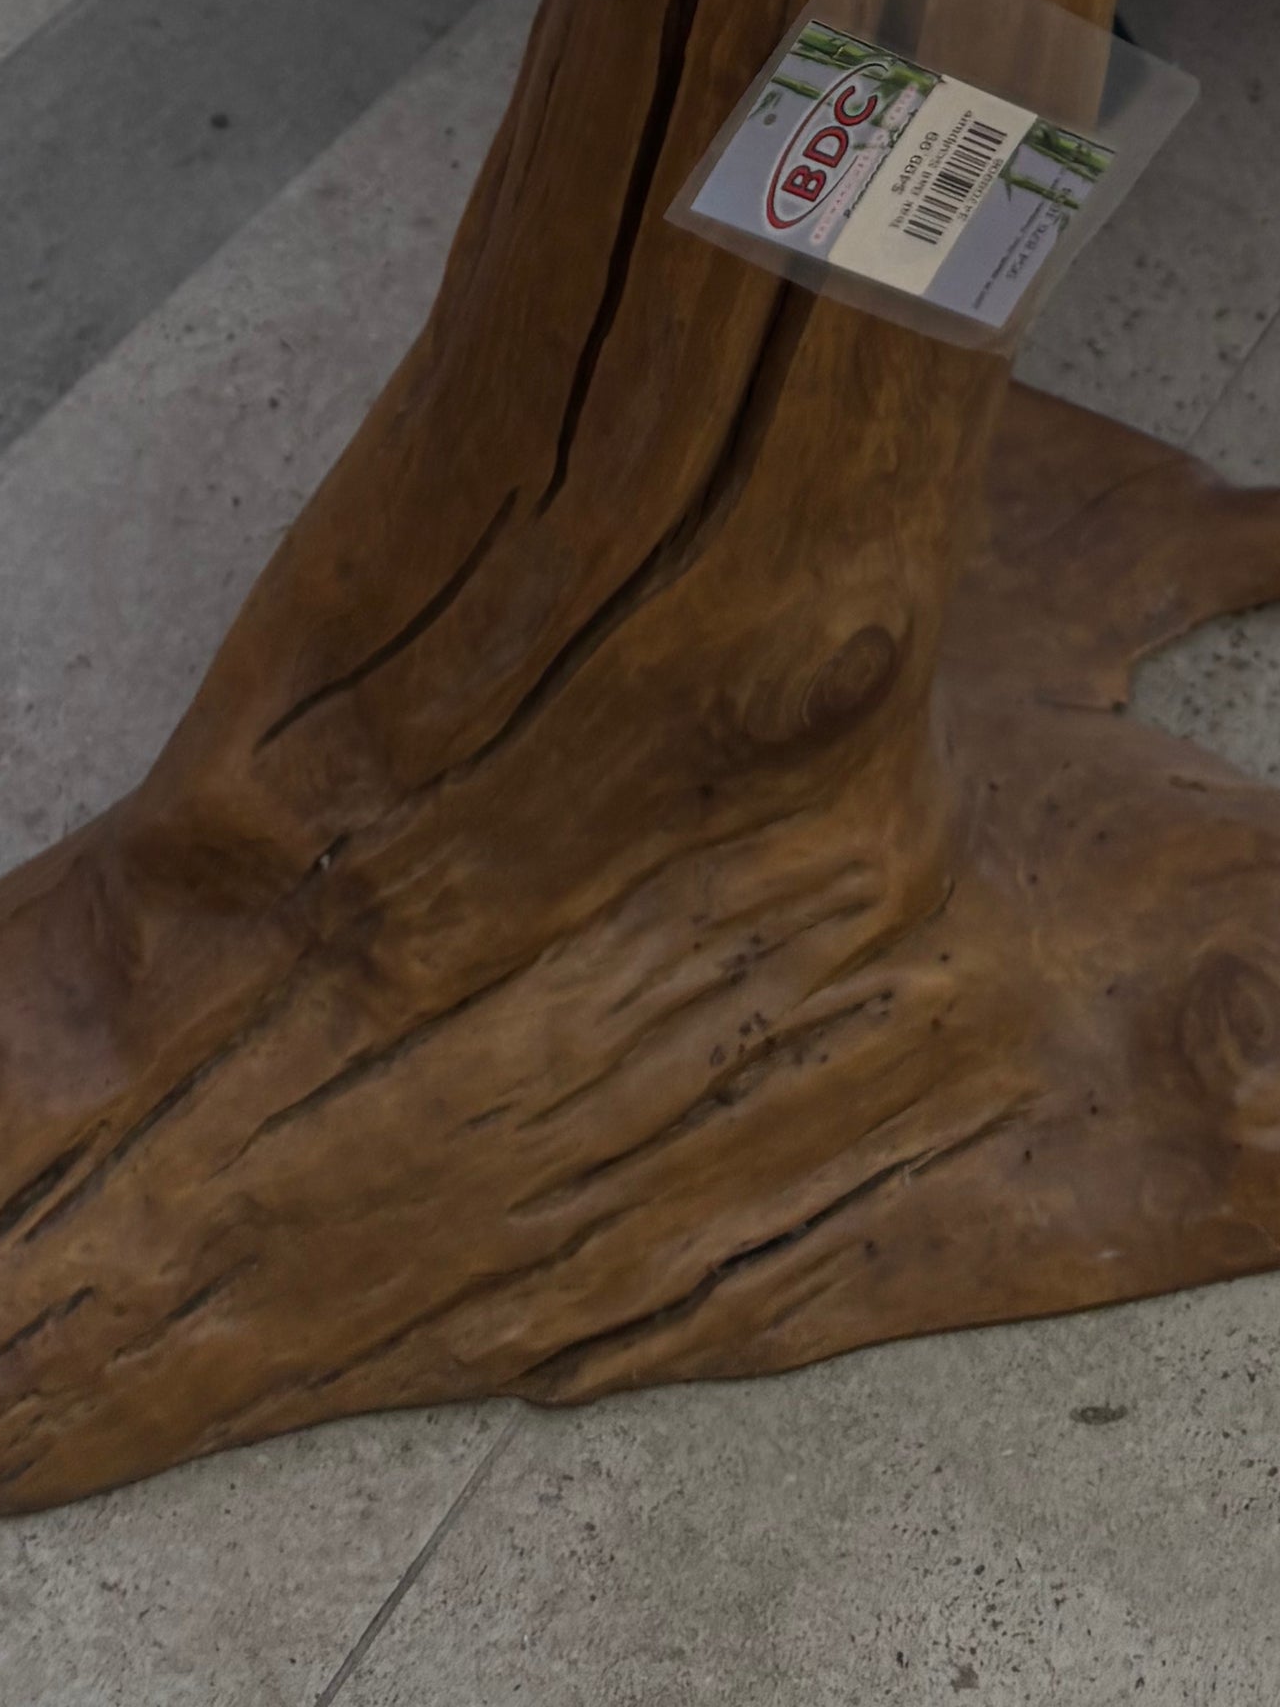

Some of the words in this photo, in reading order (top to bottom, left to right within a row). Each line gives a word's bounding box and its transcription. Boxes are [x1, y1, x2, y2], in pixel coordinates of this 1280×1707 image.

[781, 84, 878, 203] BDC
[888, 129, 941, 196] $499.99
[888, 199, 915, 230] Teak
[909, 170, 933, 196] Ball
[926, 107, 976, 170] Sculpture
